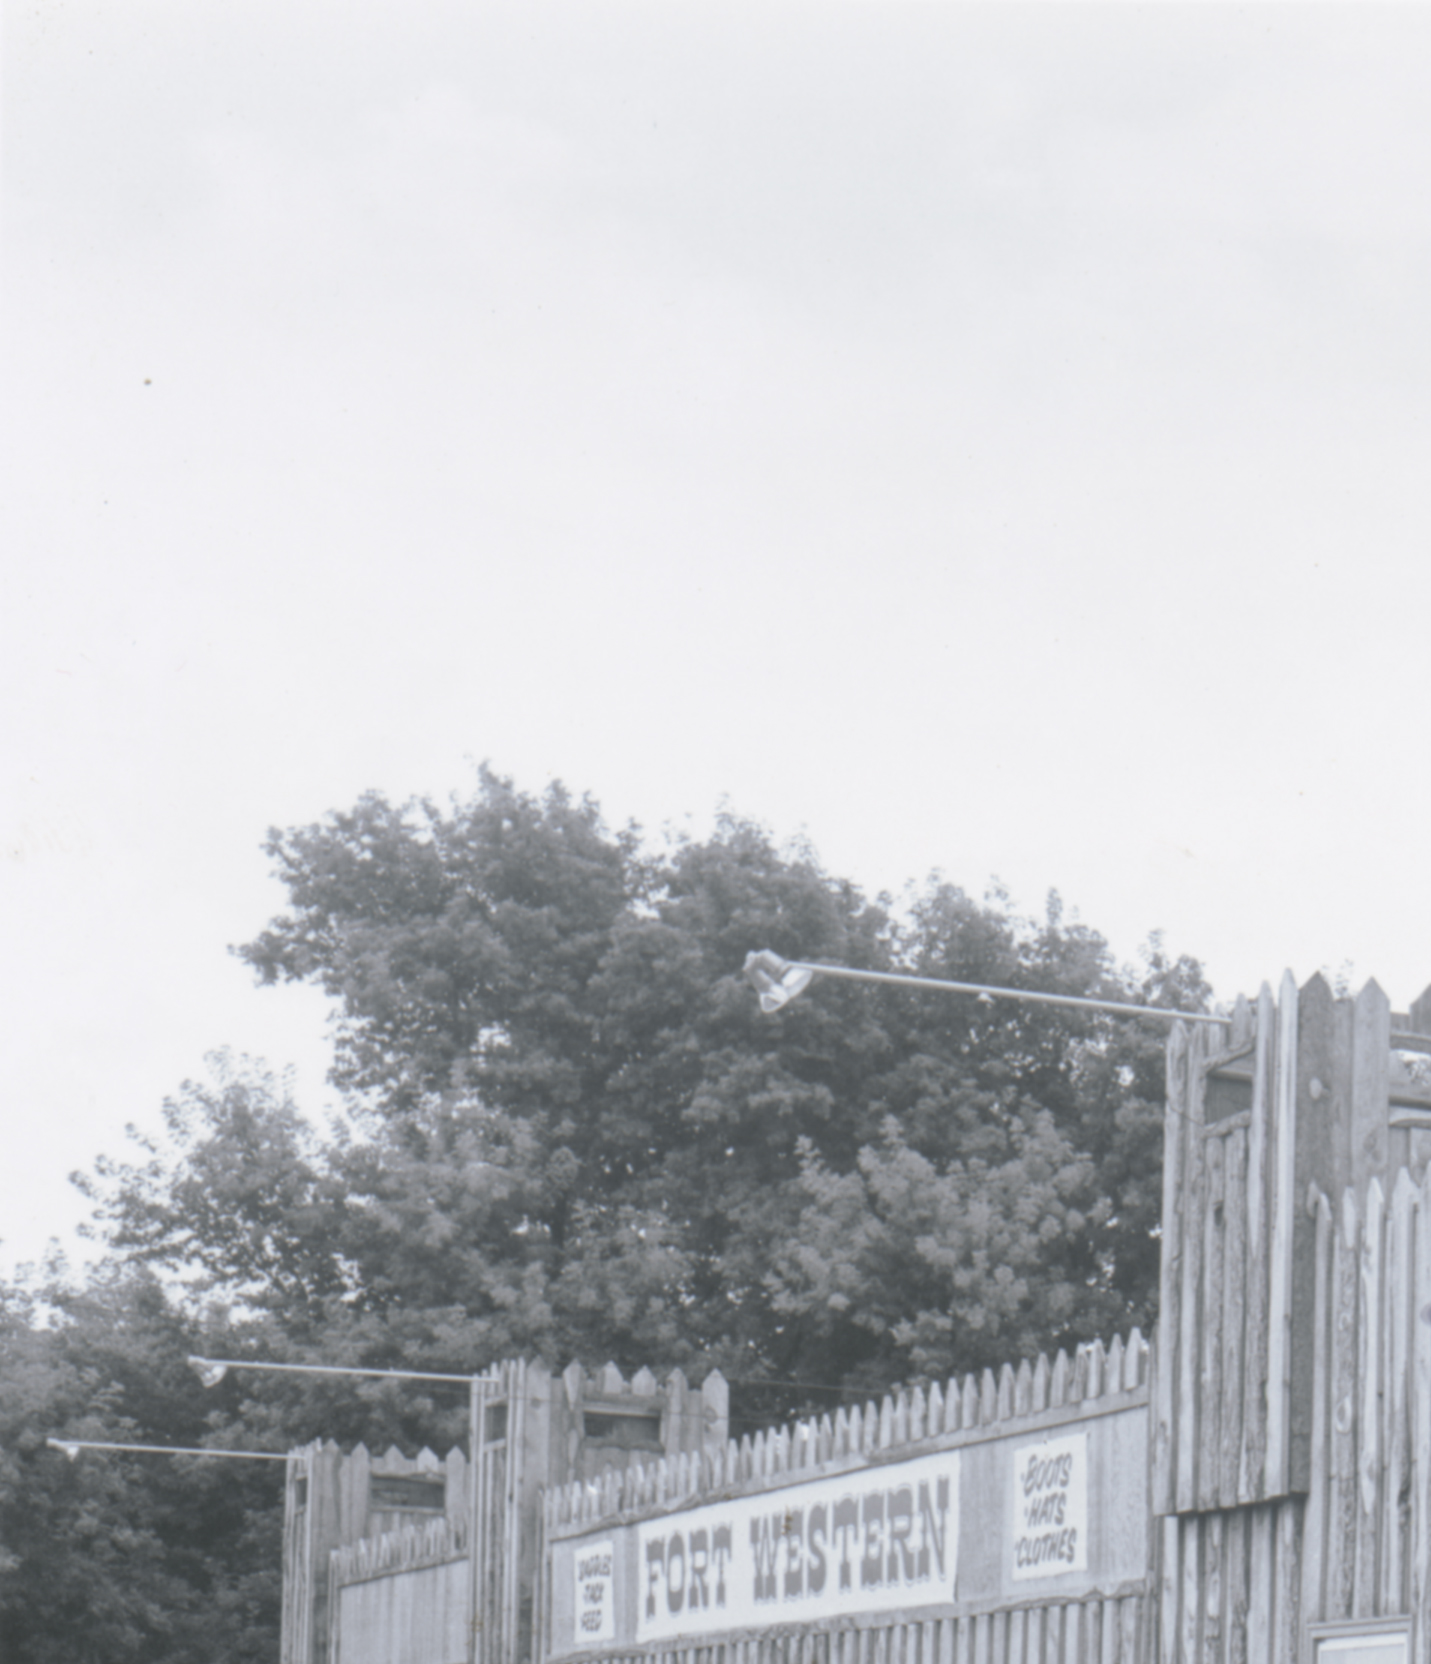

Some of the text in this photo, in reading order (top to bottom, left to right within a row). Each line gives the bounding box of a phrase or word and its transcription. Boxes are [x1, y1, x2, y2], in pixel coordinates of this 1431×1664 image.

[1023, 1451, 1073, 1498] BOOTS
[1027, 1491, 1067, 1528] HATS
[644, 1472, 951, 1624] FORT WESTERN
[1016, 1527, 1078, 1569] CLOTHES
[581, 1609, 602, 1632] FEED
